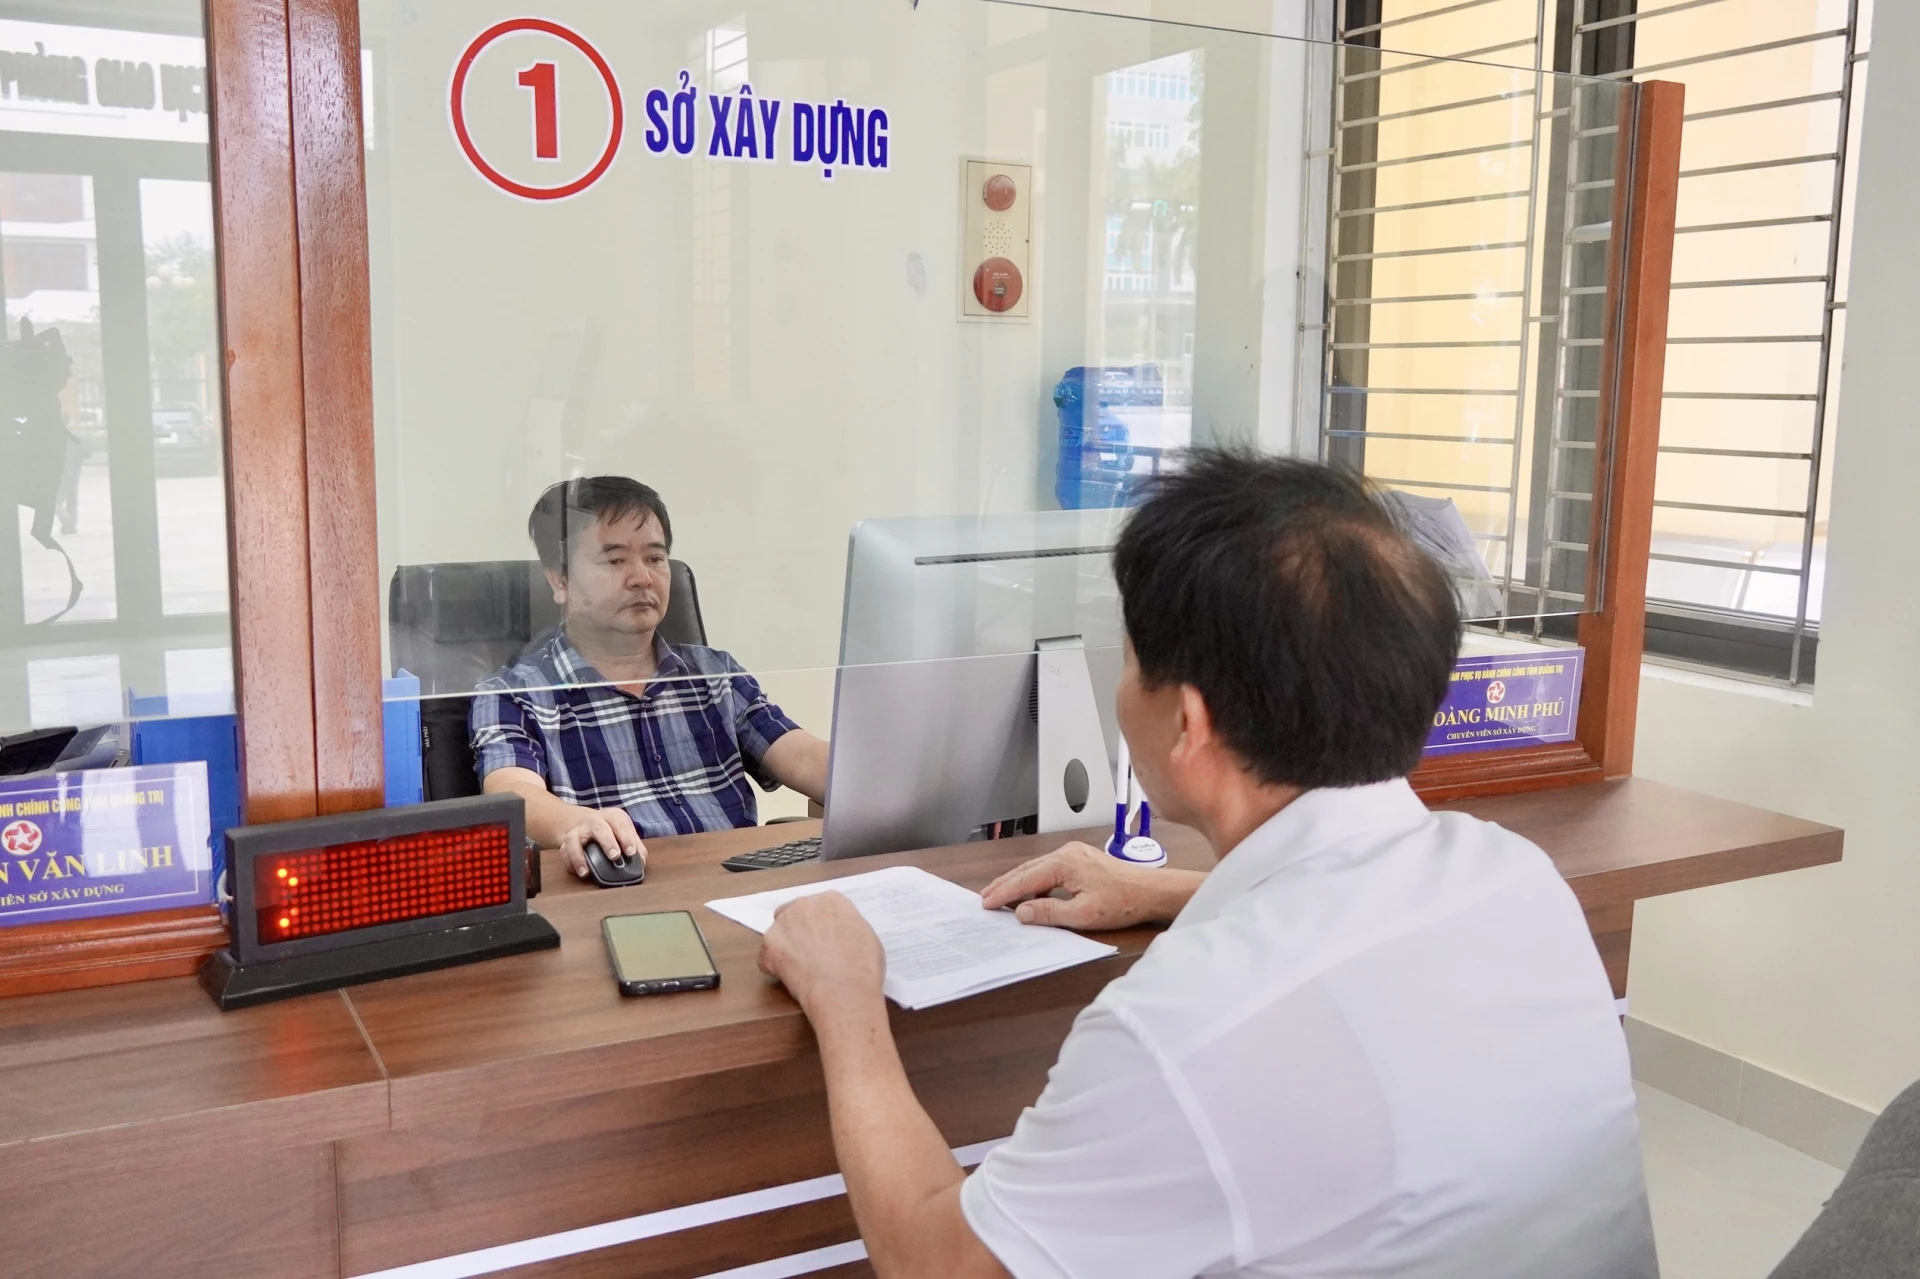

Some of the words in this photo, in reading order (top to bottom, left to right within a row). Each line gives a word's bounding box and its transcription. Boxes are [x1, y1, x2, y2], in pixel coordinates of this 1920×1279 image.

[517, 62, 558, 159] 1
[645, 70, 697, 155] SỞ
[708, 84, 781, 160] XÂY
[793, 100, 889, 178] DỰNG
[1434, 706, 1481, 727] OÀNG
[1485, 704, 1529, 722] MINH
[1532, 697, 1565, 718] PHÚ
[1476, 729, 1492, 737] VIÊN
[16, 798, 50, 817] CHÍNH
[148, 789, 164, 806] TRỊ
[17, 851, 87, 882] VĂN
[96, 845, 174, 875] LINH
[0, 893, 25, 906] IÊN
[29, 888, 48, 903] SỞ
[51, 887, 81, 901] XÂY
[84, 883, 125, 899] DỰNG
